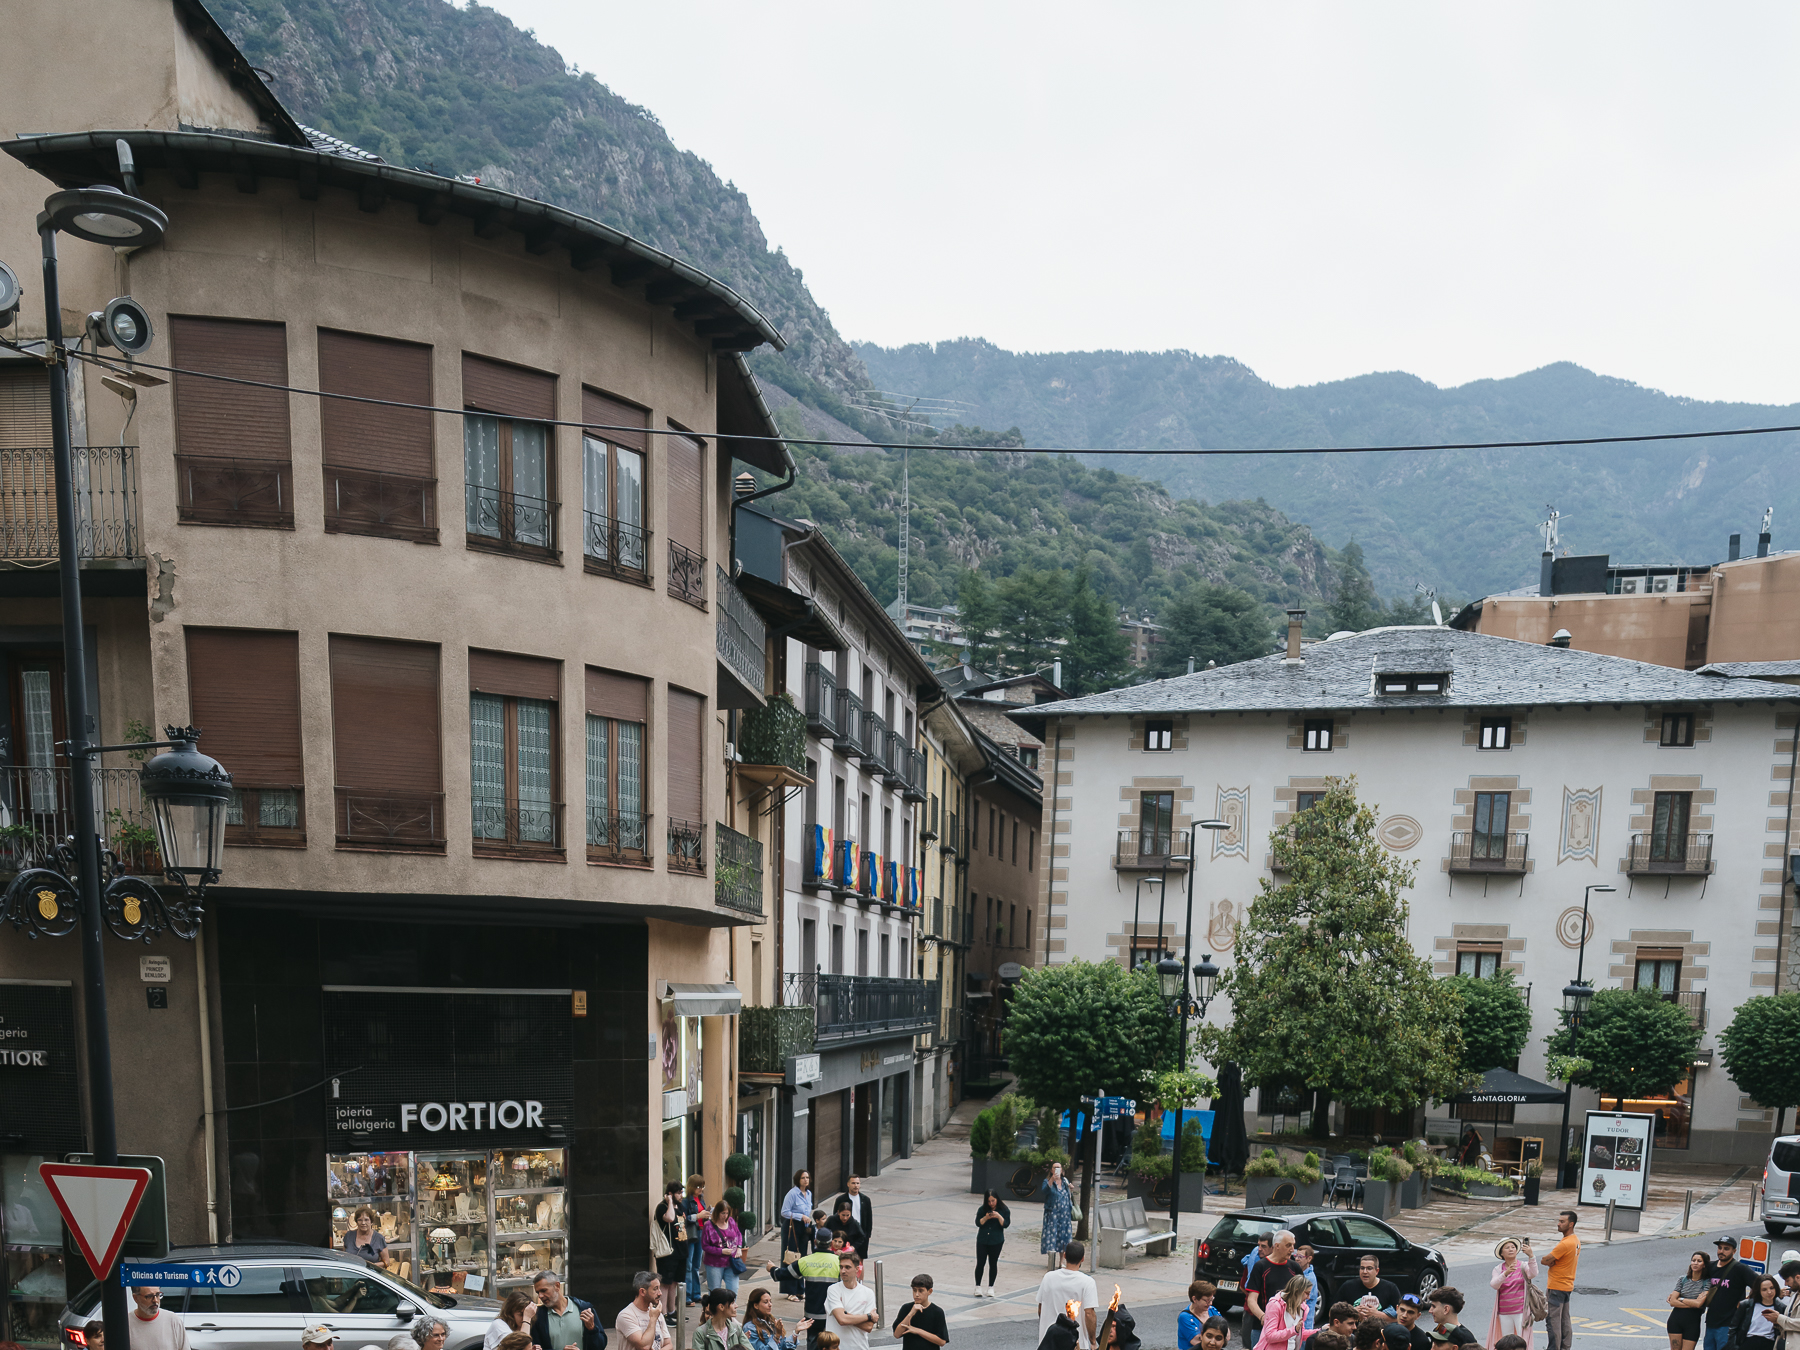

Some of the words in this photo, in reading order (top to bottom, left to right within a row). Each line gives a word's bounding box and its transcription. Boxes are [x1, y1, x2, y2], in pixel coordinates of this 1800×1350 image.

[153, 993, 162, 1008] 2
[336, 1106, 373, 1119] joieria
[401, 1100, 544, 1132] FORTIOR
[336, 1119, 396, 1132] rellotgeria
[131, 1271, 154, 1280] Oficina
[154, 1271, 163, 1280] de
[163, 1271, 189, 1280] Turisme
